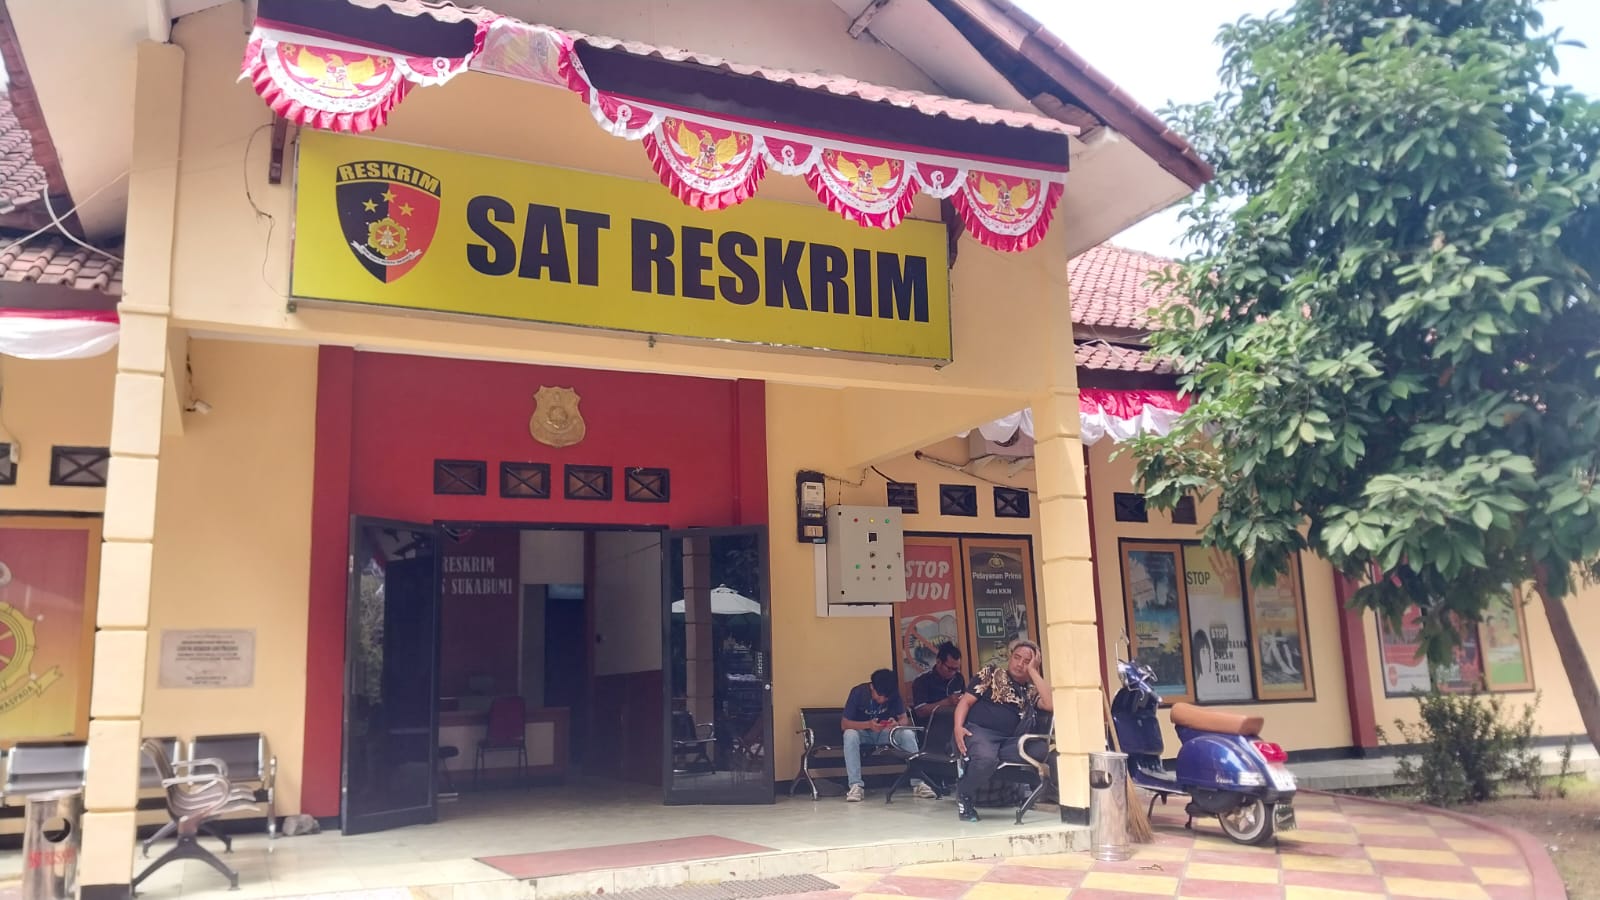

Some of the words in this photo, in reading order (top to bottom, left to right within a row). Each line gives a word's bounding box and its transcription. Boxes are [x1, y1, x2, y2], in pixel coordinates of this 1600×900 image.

[338, 162, 440, 193] RESKRIM
[466, 195, 610, 287] SAT
[631, 217, 929, 323] RESKRIM
[905, 560, 950, 578] STOP
[451, 578, 513, 595] SUKABUMI
[1186, 571, 1210, 585] STOP
[906, 582, 951, 600] JUDI
[1211, 628, 1227, 639] STOP
[1214, 661, 1236, 672] RUMAH
[1216, 673, 1240, 684] TANGGA
